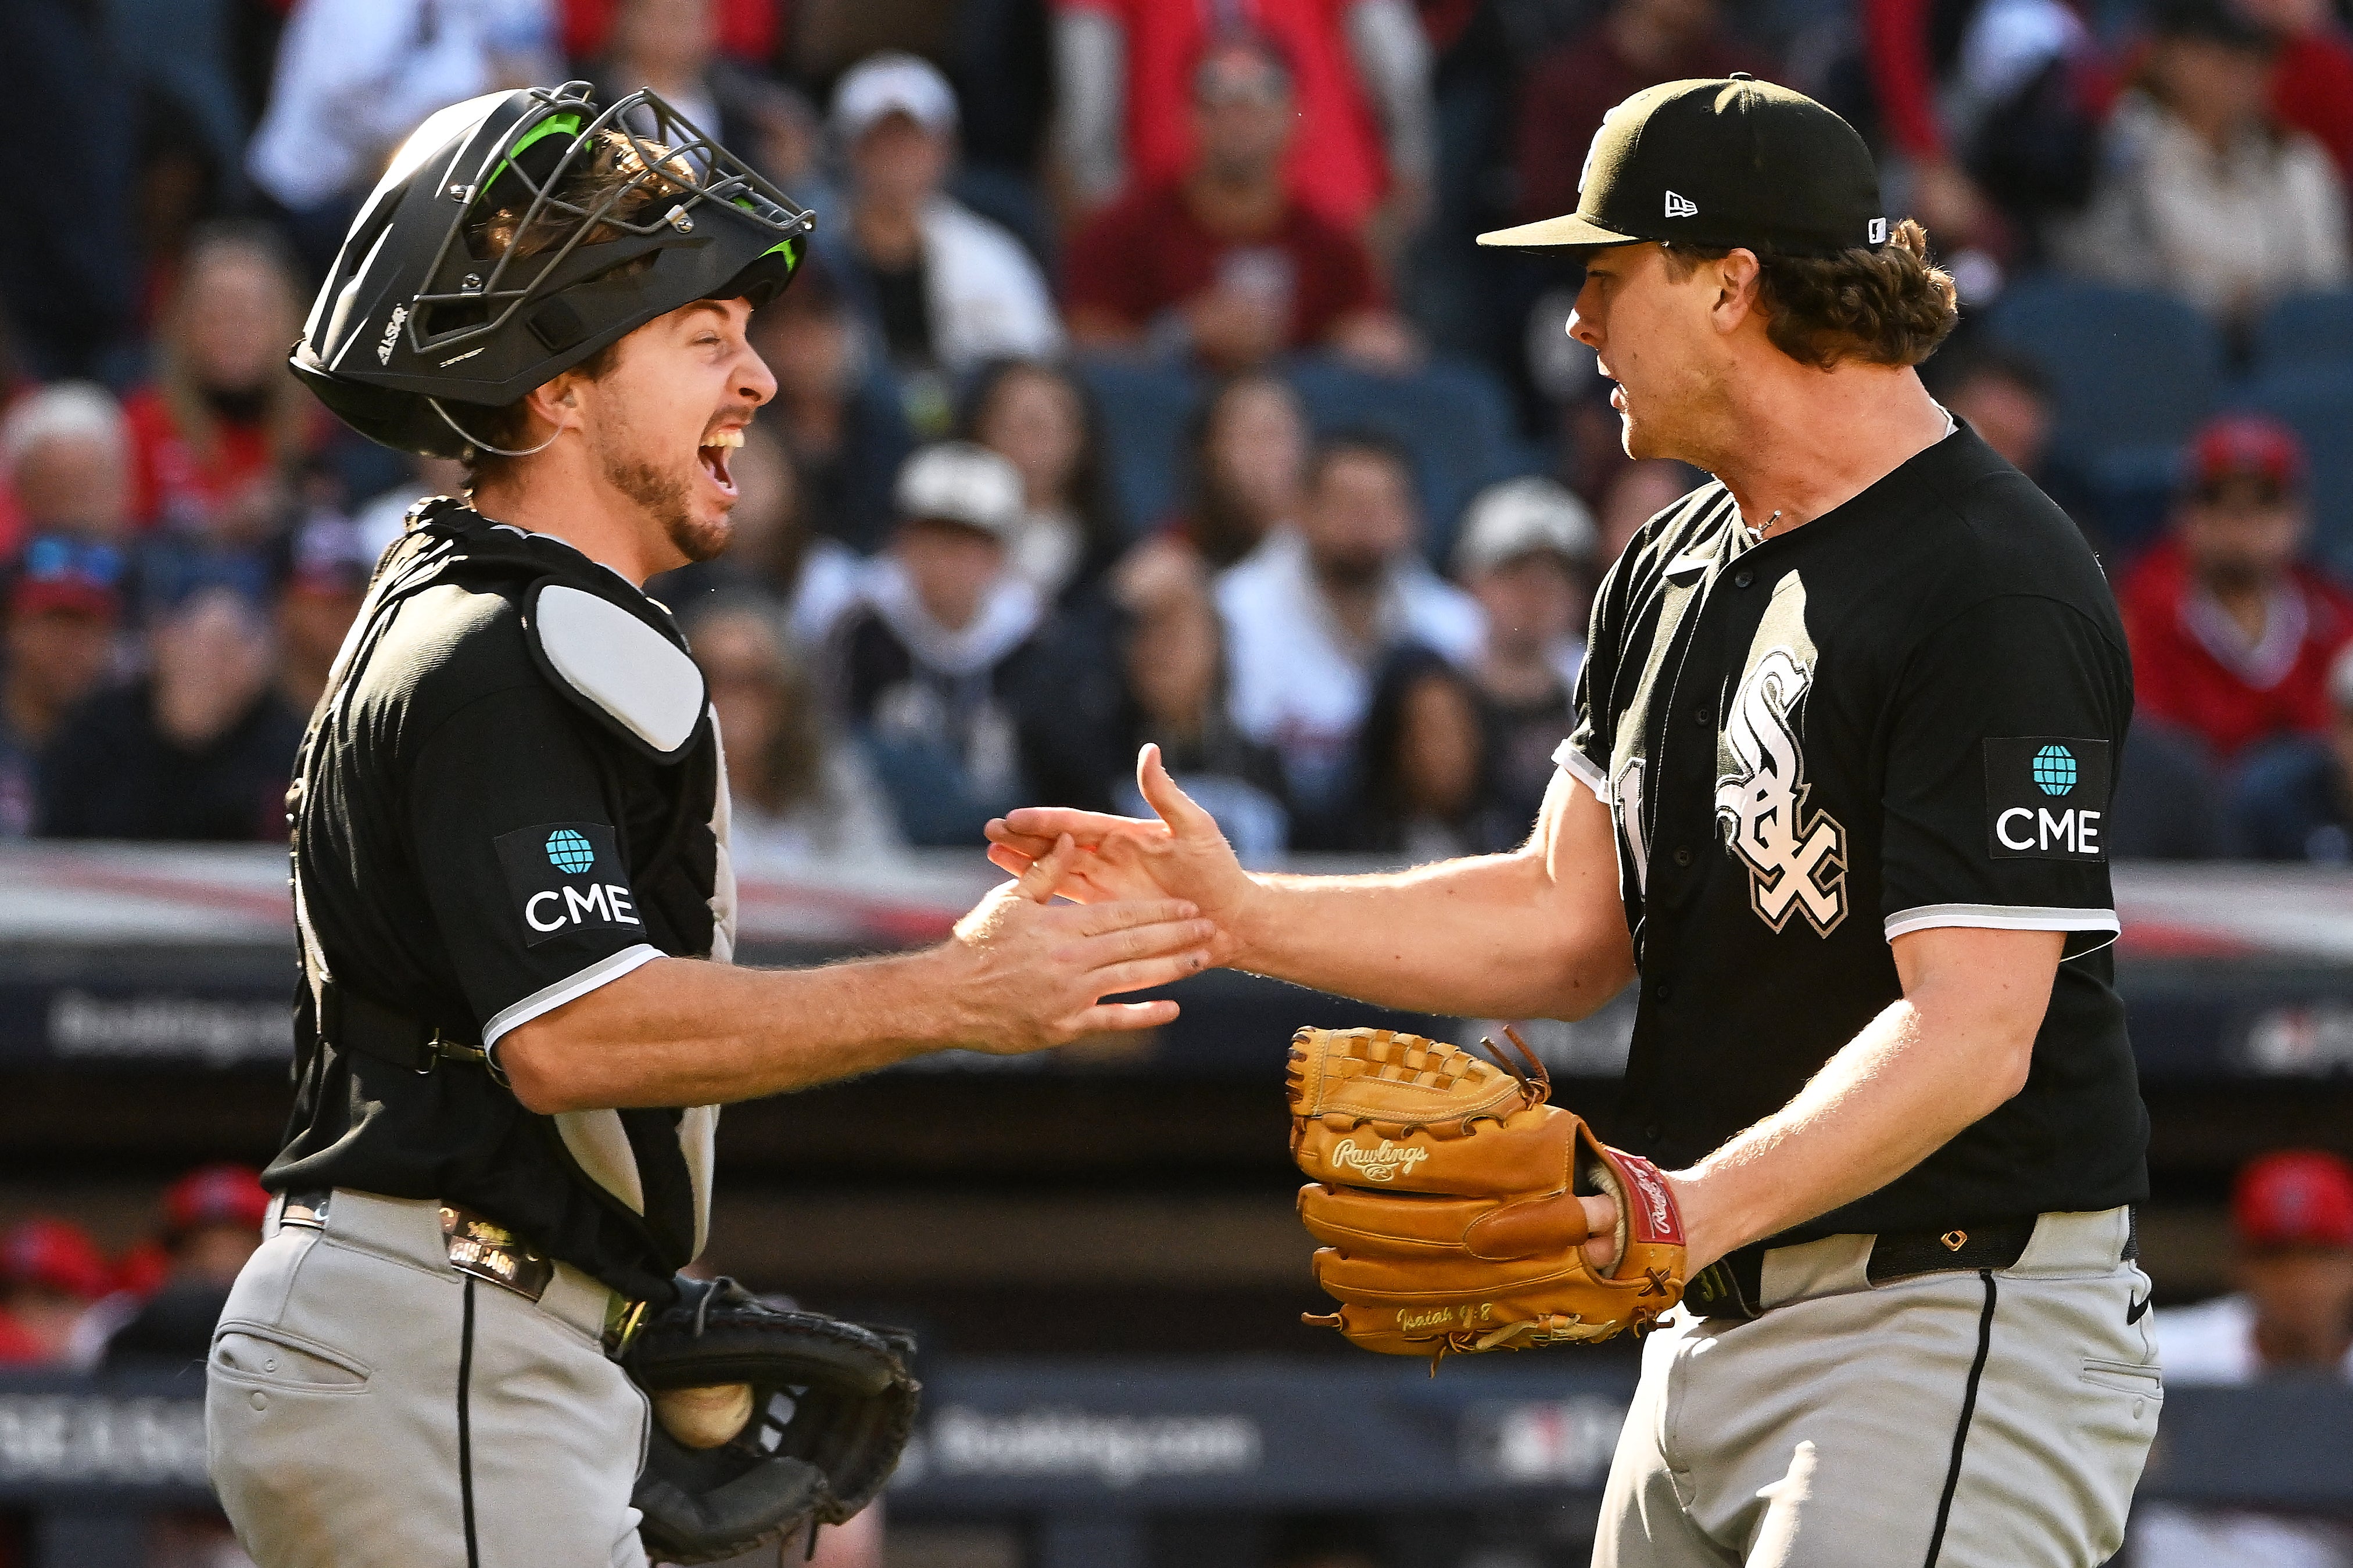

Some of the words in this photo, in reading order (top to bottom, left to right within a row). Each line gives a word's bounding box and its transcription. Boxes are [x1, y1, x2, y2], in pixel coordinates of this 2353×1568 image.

[1996, 807, 2101, 853] CME
[525, 883, 640, 932] CME
[1333, 1139, 1429, 1176] Rawlings
